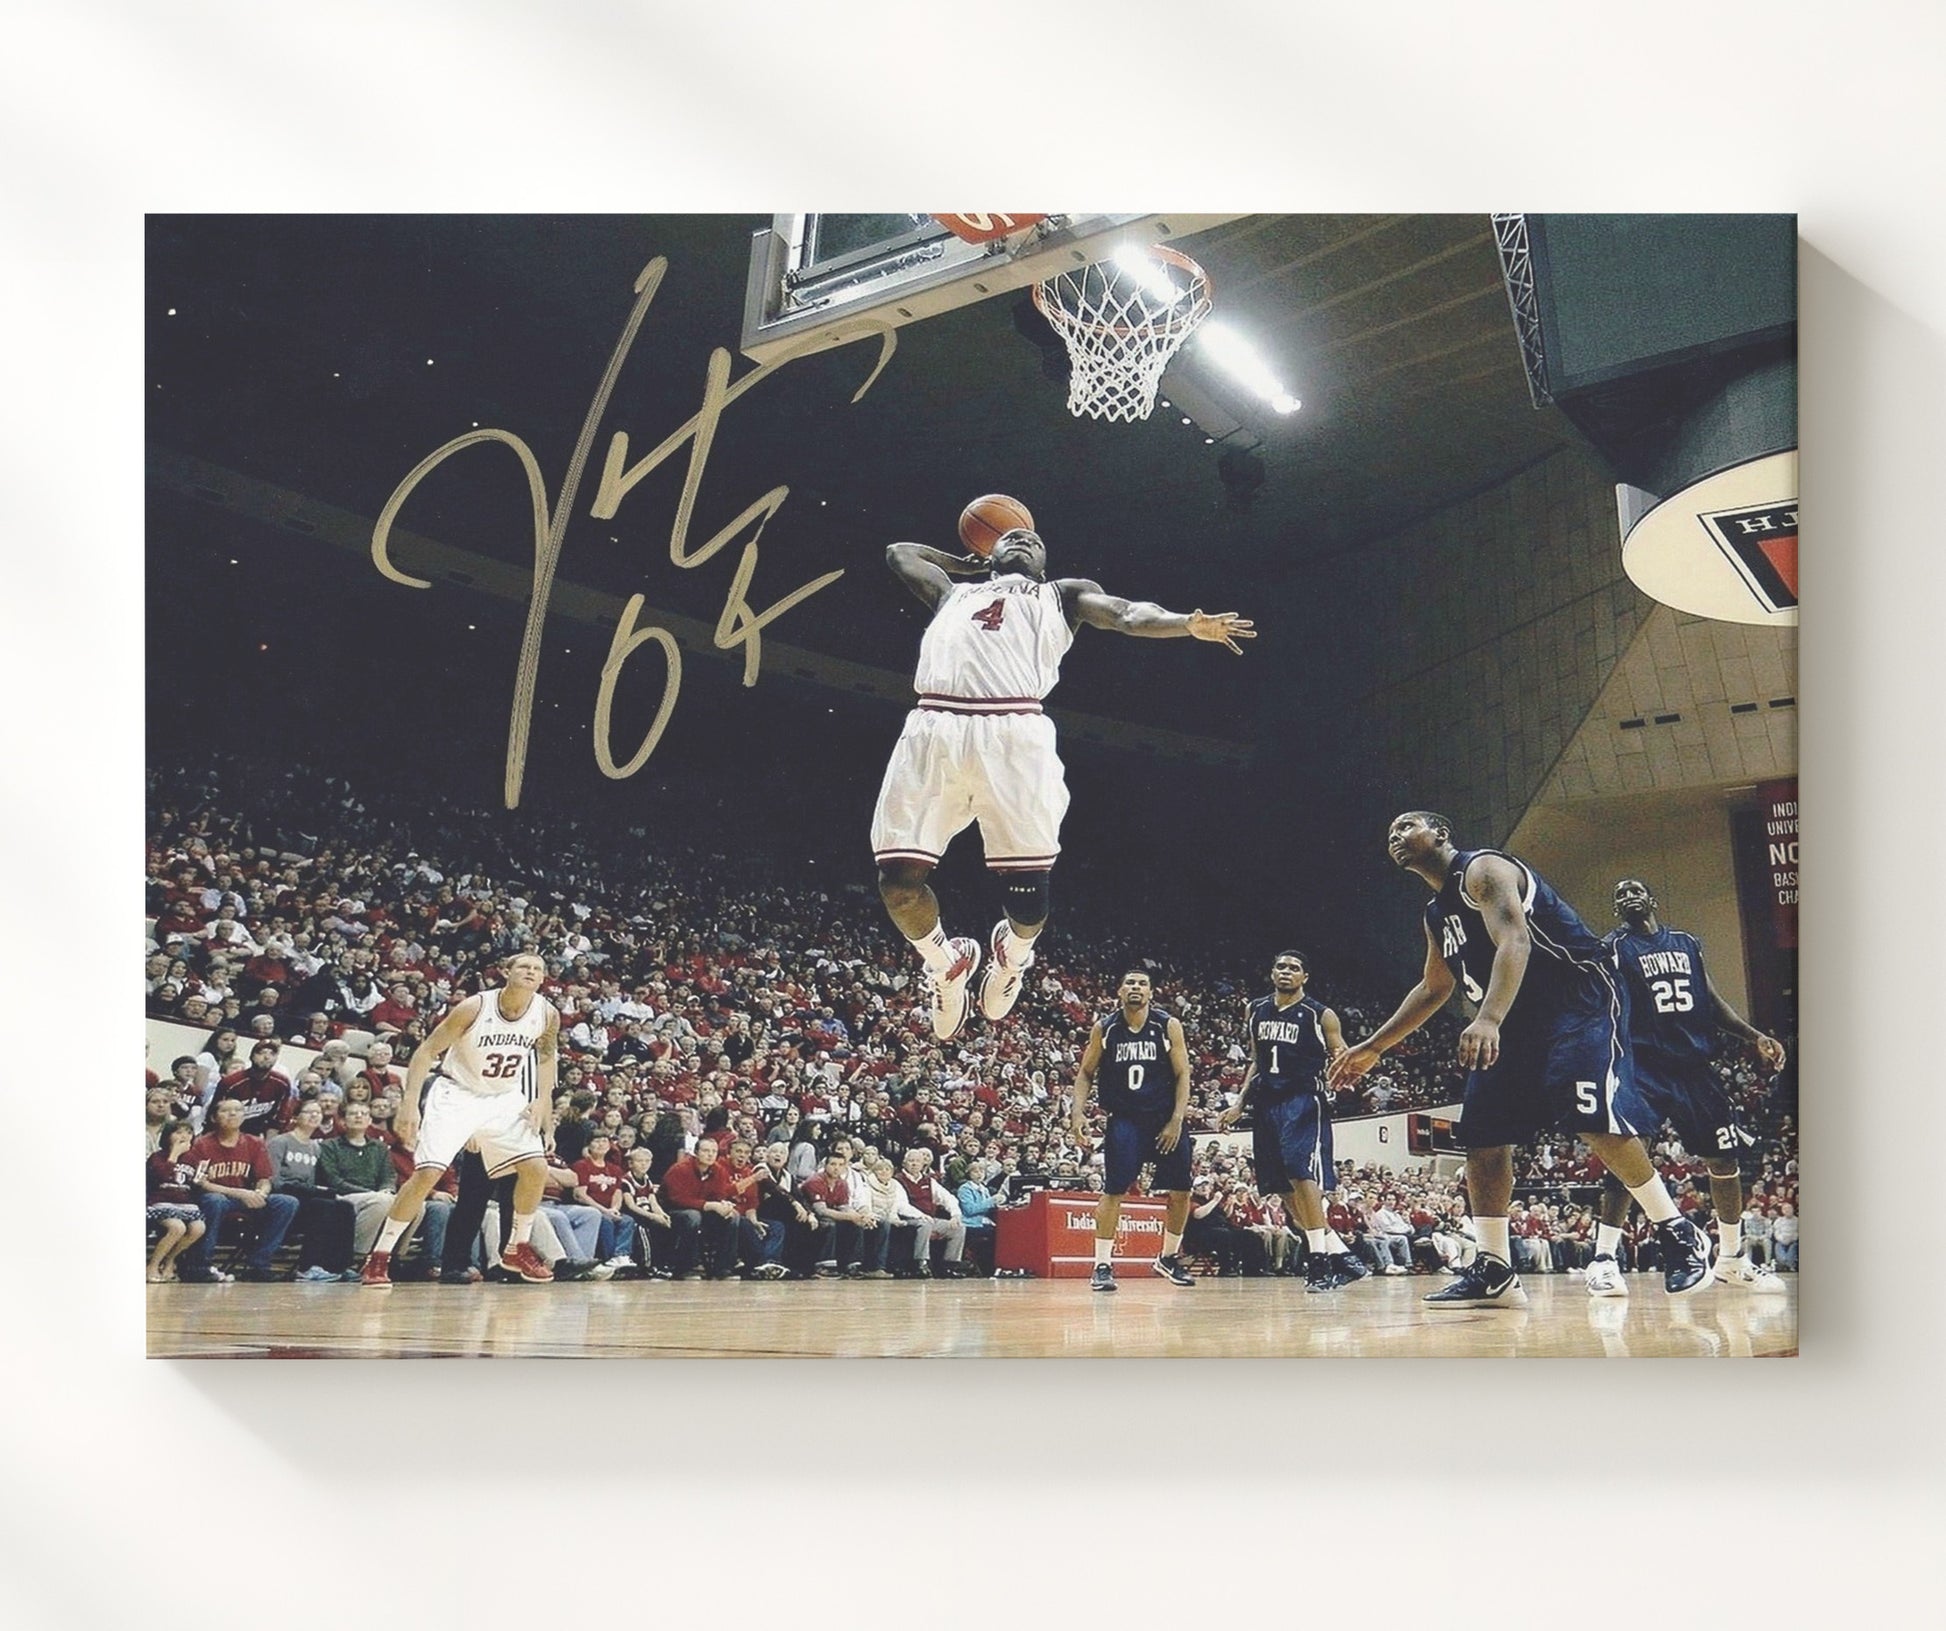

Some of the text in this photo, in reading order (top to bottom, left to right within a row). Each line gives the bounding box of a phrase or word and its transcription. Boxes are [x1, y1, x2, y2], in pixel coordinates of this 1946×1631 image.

[971, 598, 1006, 631] 4
[1774, 872, 1798, 887] BAS
[1639, 951, 1691, 978] HOWARD
[1651, 979, 1694, 1013] 25
[1258, 1020, 1299, 1044] HOWARD
[482, 1053, 522, 1078] 32
[1115, 1041, 1157, 1063] HOWARD
[1269, 1045, 1280, 1074] 1
[1128, 1064, 1145, 1091] 0
[1575, 1081, 1598, 1115] 5
[1066, 1211, 1098, 1230] India
